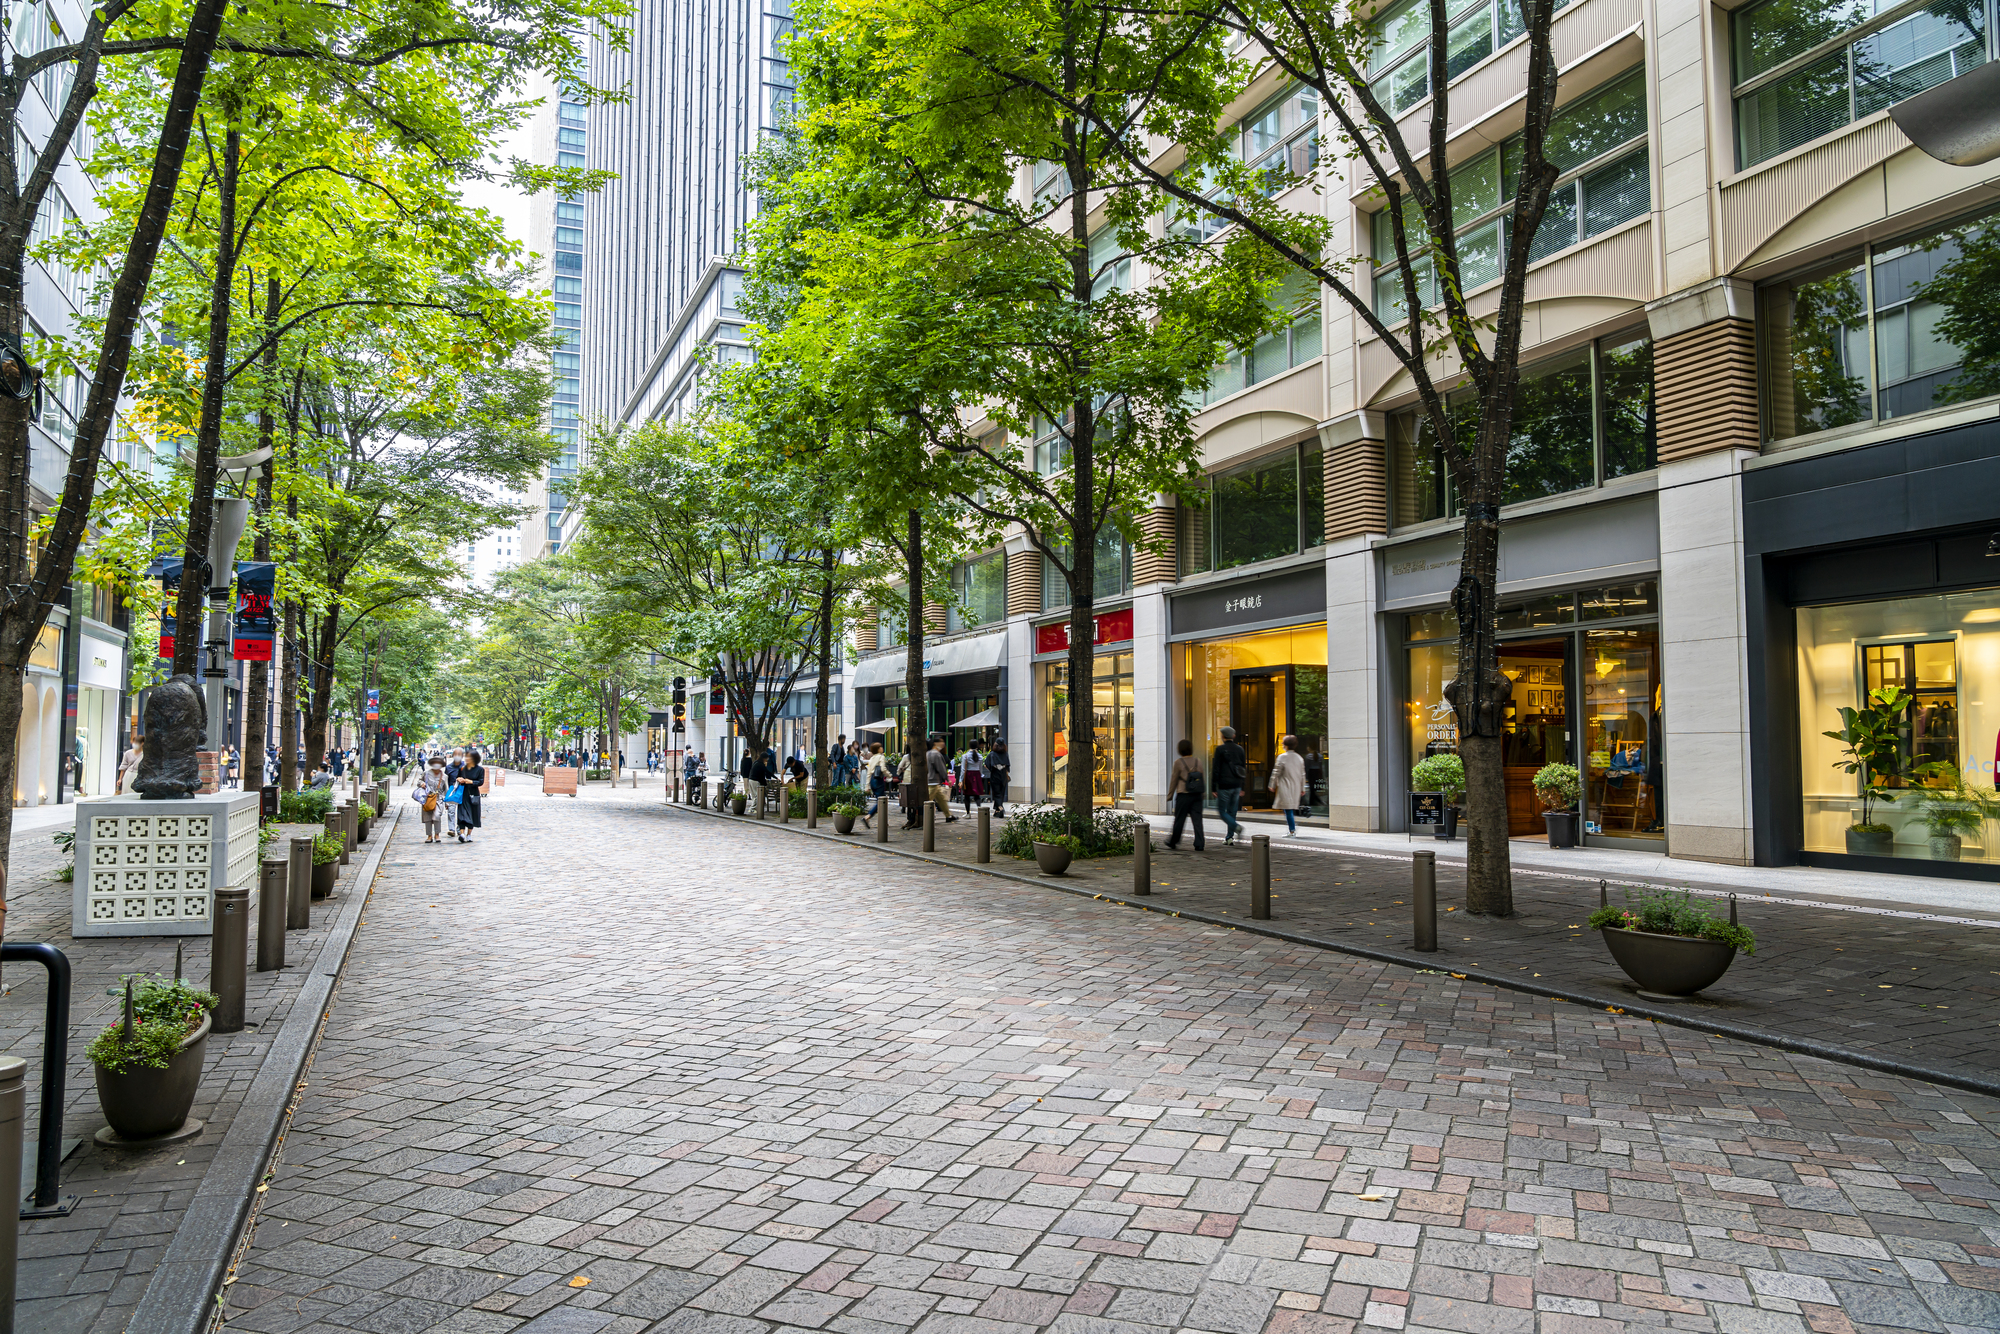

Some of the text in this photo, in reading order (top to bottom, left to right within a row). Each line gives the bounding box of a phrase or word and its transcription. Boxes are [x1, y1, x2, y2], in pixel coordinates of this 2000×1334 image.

[240, 600, 270, 608] FILM
[1225, 594, 1262, 613] 金子眼鏡店
[1427, 731, 1456, 740] ORDER
